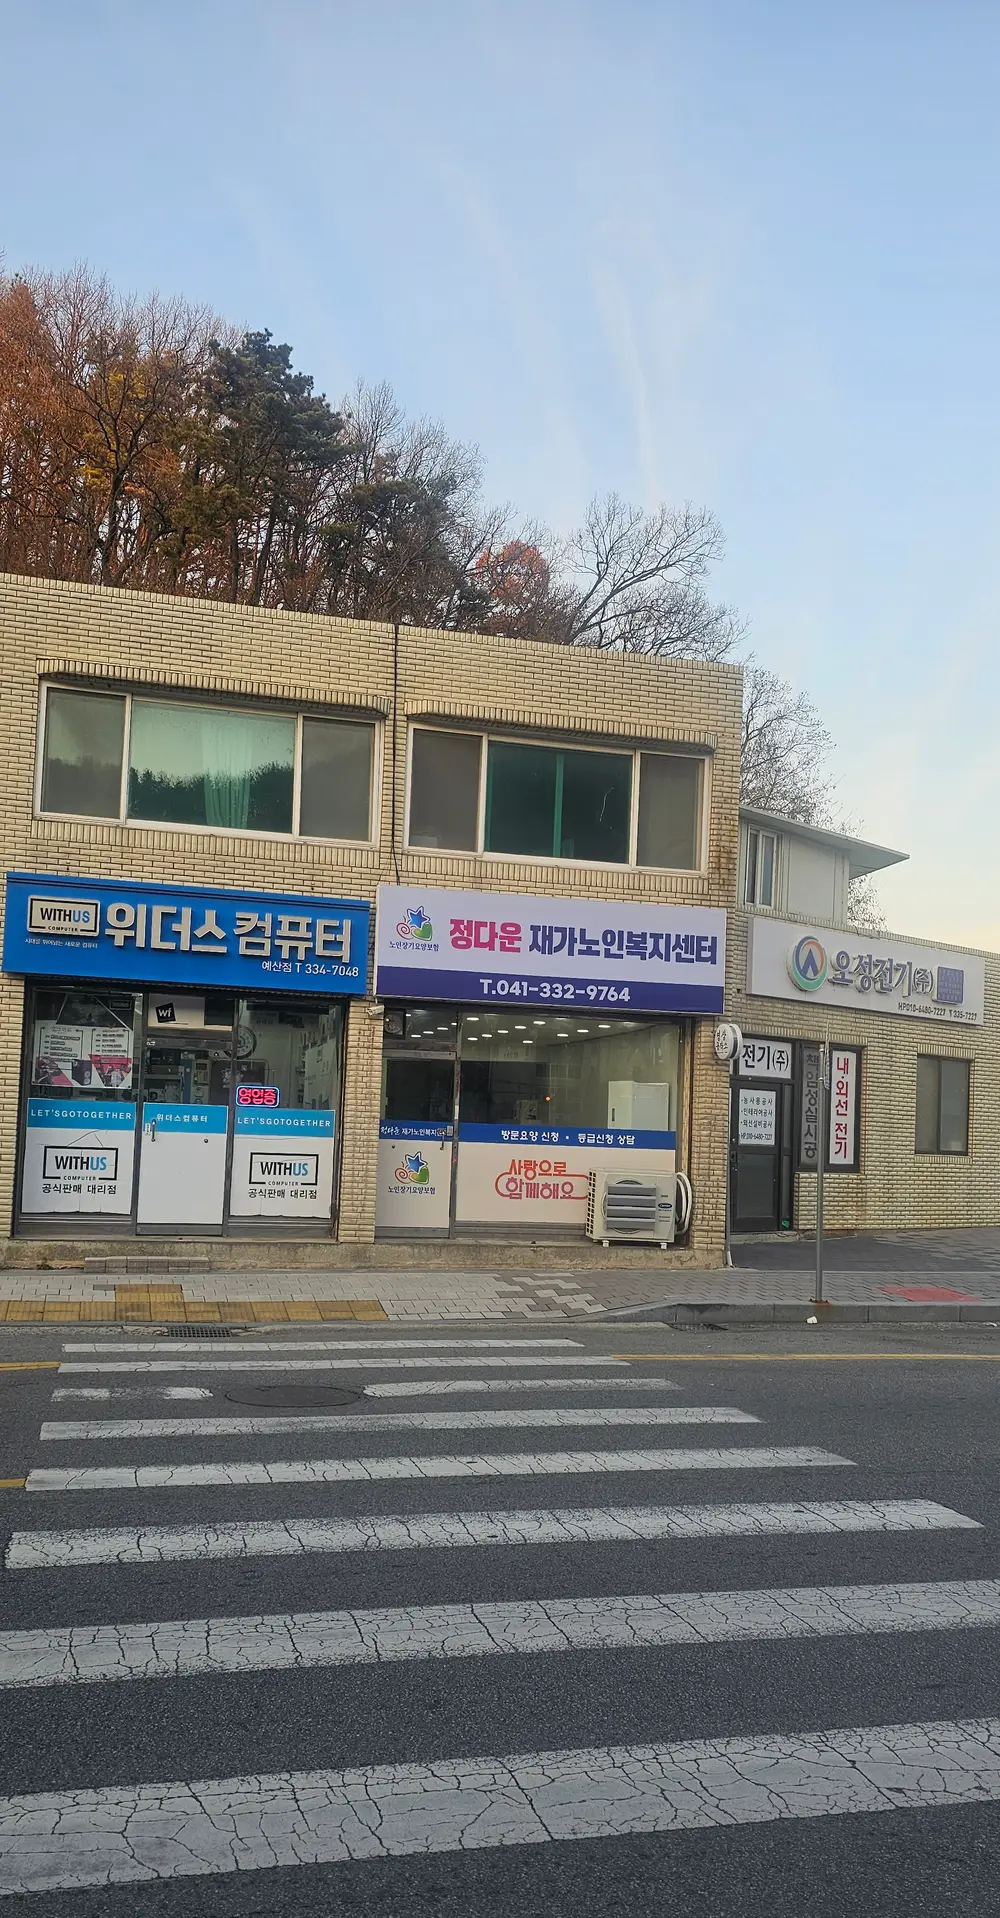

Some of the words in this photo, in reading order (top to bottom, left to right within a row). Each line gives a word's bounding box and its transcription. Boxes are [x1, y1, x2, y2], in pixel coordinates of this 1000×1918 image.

[40, 907, 90, 923] WITHUS
[389, 941, 439, 952] 노인장기요양보험
[449, 918, 522, 953] 정다운
[529, 924, 718, 965] 재가노인복지센터
[261, 961, 292, 973] 예산점
[295, 963, 302, 973] T
[305, 963, 359, 977] 334-7048
[479, 978, 631, 1002] T.041-332-9764
[742, 1044, 789, 1072] 전기(주)
[31, 1109, 132, 1120] LET'SGOTOGETHER
[237, 1117, 331, 1127] LET'SGOTOGETHER
[401, 1127, 447, 1137] 재가노인복지
[501, 1130, 539, 1142] 방문요양
[541, 1132, 559, 1142] 신청
[577, 1133, 614, 1144] 등급신청
[617, 1135, 636, 1145] 상담
[834, 1122, 847, 1159] 전기
[55, 1155, 107, 1171] WITHUS
[260, 1161, 308, 1177] WITHUS
[508, 1159, 568, 1181] 사랑으로
[42, 1183, 82, 1194] 공식판매
[87, 1184, 117, 1195] 대리점
[248, 1188, 286, 1199] 공식판매
[290, 1189, 317, 1200] 대리점
[388, 1186, 436, 1195] 노인장기요양보험
[505, 1177, 574, 1200] 함께해요
